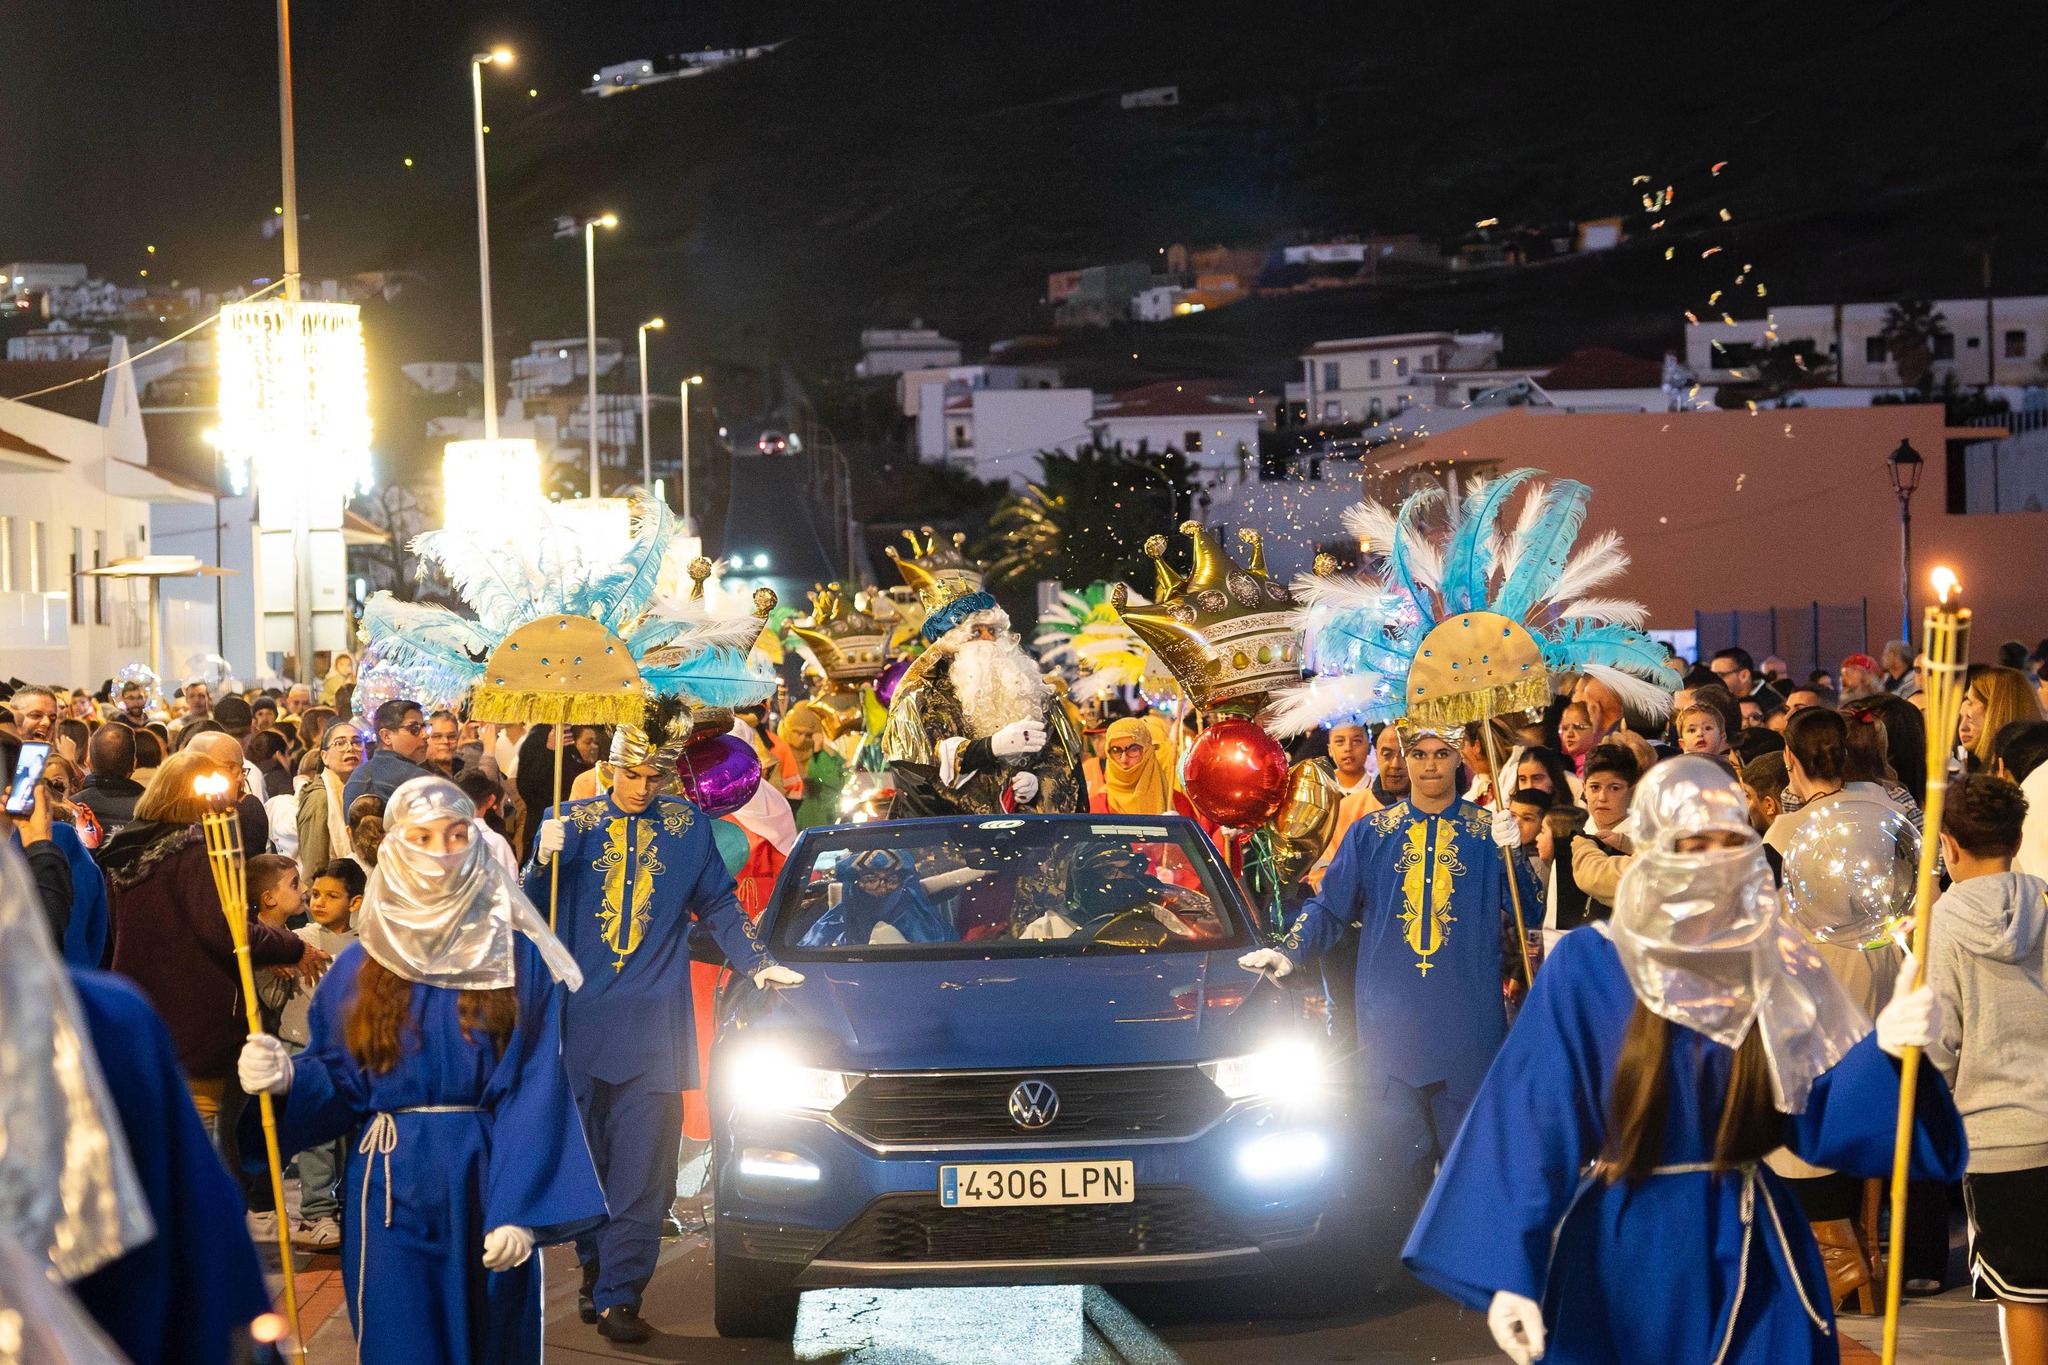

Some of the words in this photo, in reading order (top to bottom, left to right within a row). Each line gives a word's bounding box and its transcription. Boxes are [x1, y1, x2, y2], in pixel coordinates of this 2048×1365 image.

[1010, 1081, 1058, 1127] VW
[946, 1190, 954, 1199] E
[966, 1169, 1047, 1200] 4306
[1061, 1167, 1121, 1197] LPN
